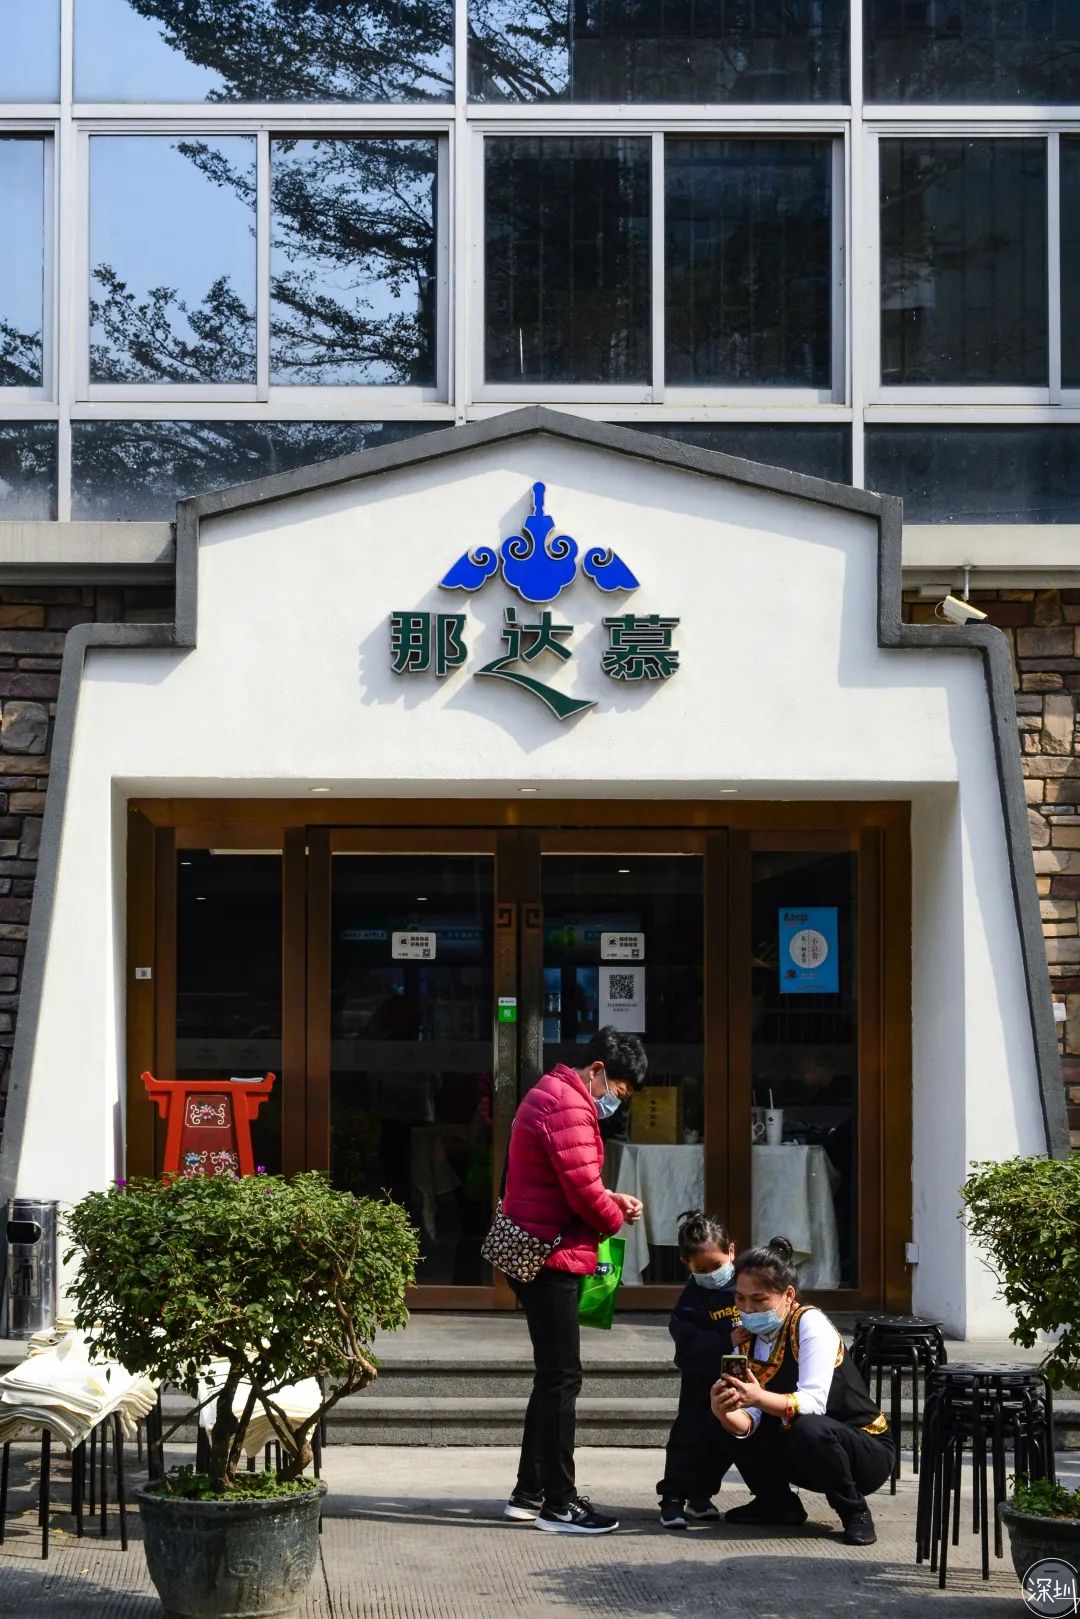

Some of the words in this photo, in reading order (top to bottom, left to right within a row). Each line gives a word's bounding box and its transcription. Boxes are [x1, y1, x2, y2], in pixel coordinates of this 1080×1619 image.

[390, 606, 681, 720] 那达慕
[708, 1305, 740, 1321] Imag
